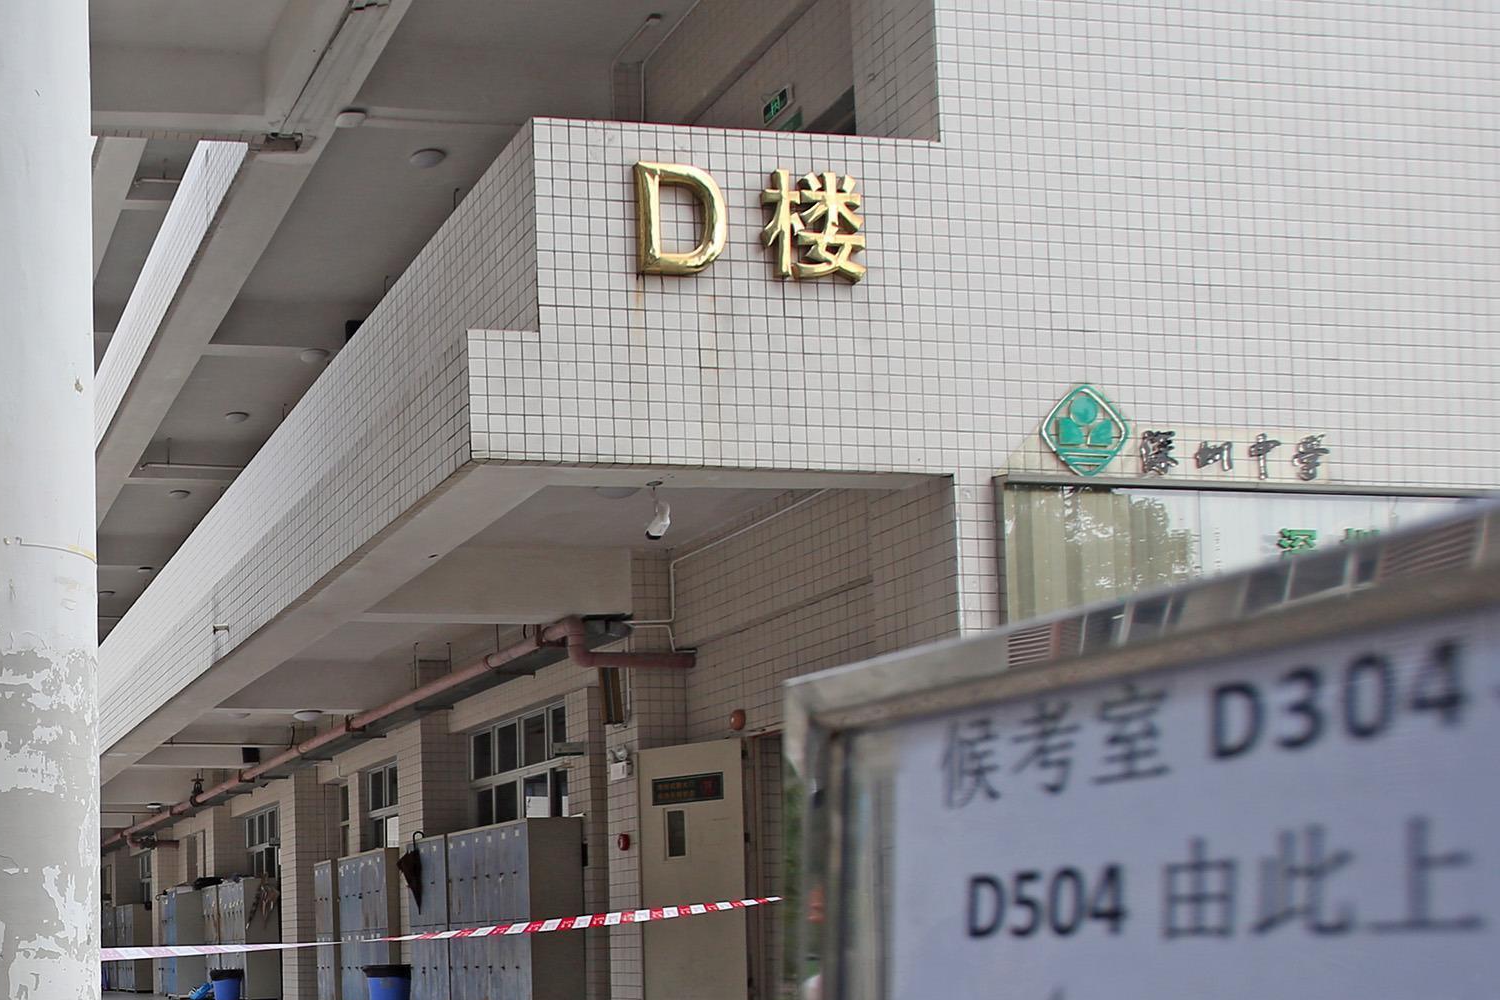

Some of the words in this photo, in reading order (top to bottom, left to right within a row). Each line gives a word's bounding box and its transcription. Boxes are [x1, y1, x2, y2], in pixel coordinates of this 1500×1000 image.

[1140, 430, 1330, 481] 深圳中学
[940, 681, 1171, 810] 候考室
[1209, 638, 1468, 760] D304
[967, 864, 1128, 940] D504
[1161, 816, 1485, 940] 由此上
